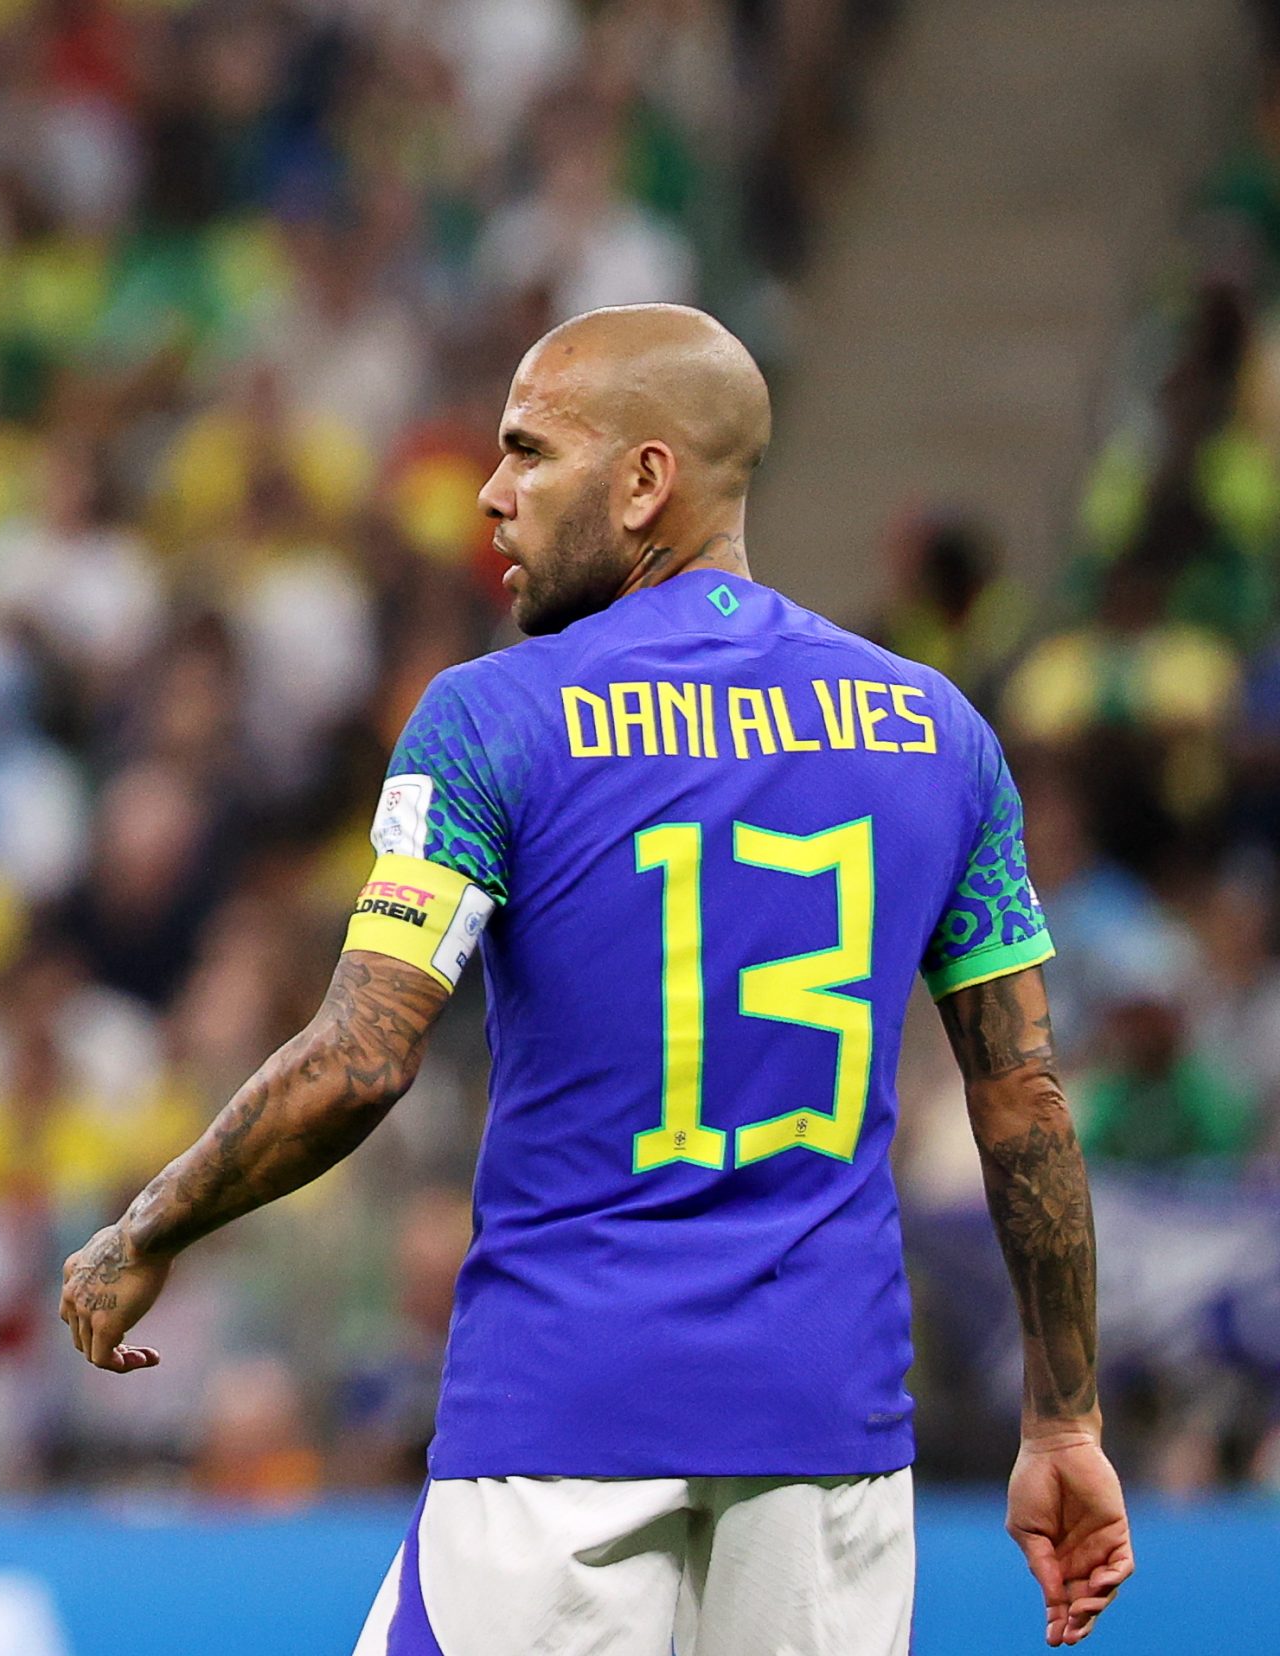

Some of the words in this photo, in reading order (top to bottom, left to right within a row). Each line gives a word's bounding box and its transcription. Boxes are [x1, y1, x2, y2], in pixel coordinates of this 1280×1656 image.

[561, 681, 718, 758] DANI
[728, 679, 937, 759] ALVES
[632, 815, 875, 1174] 13
